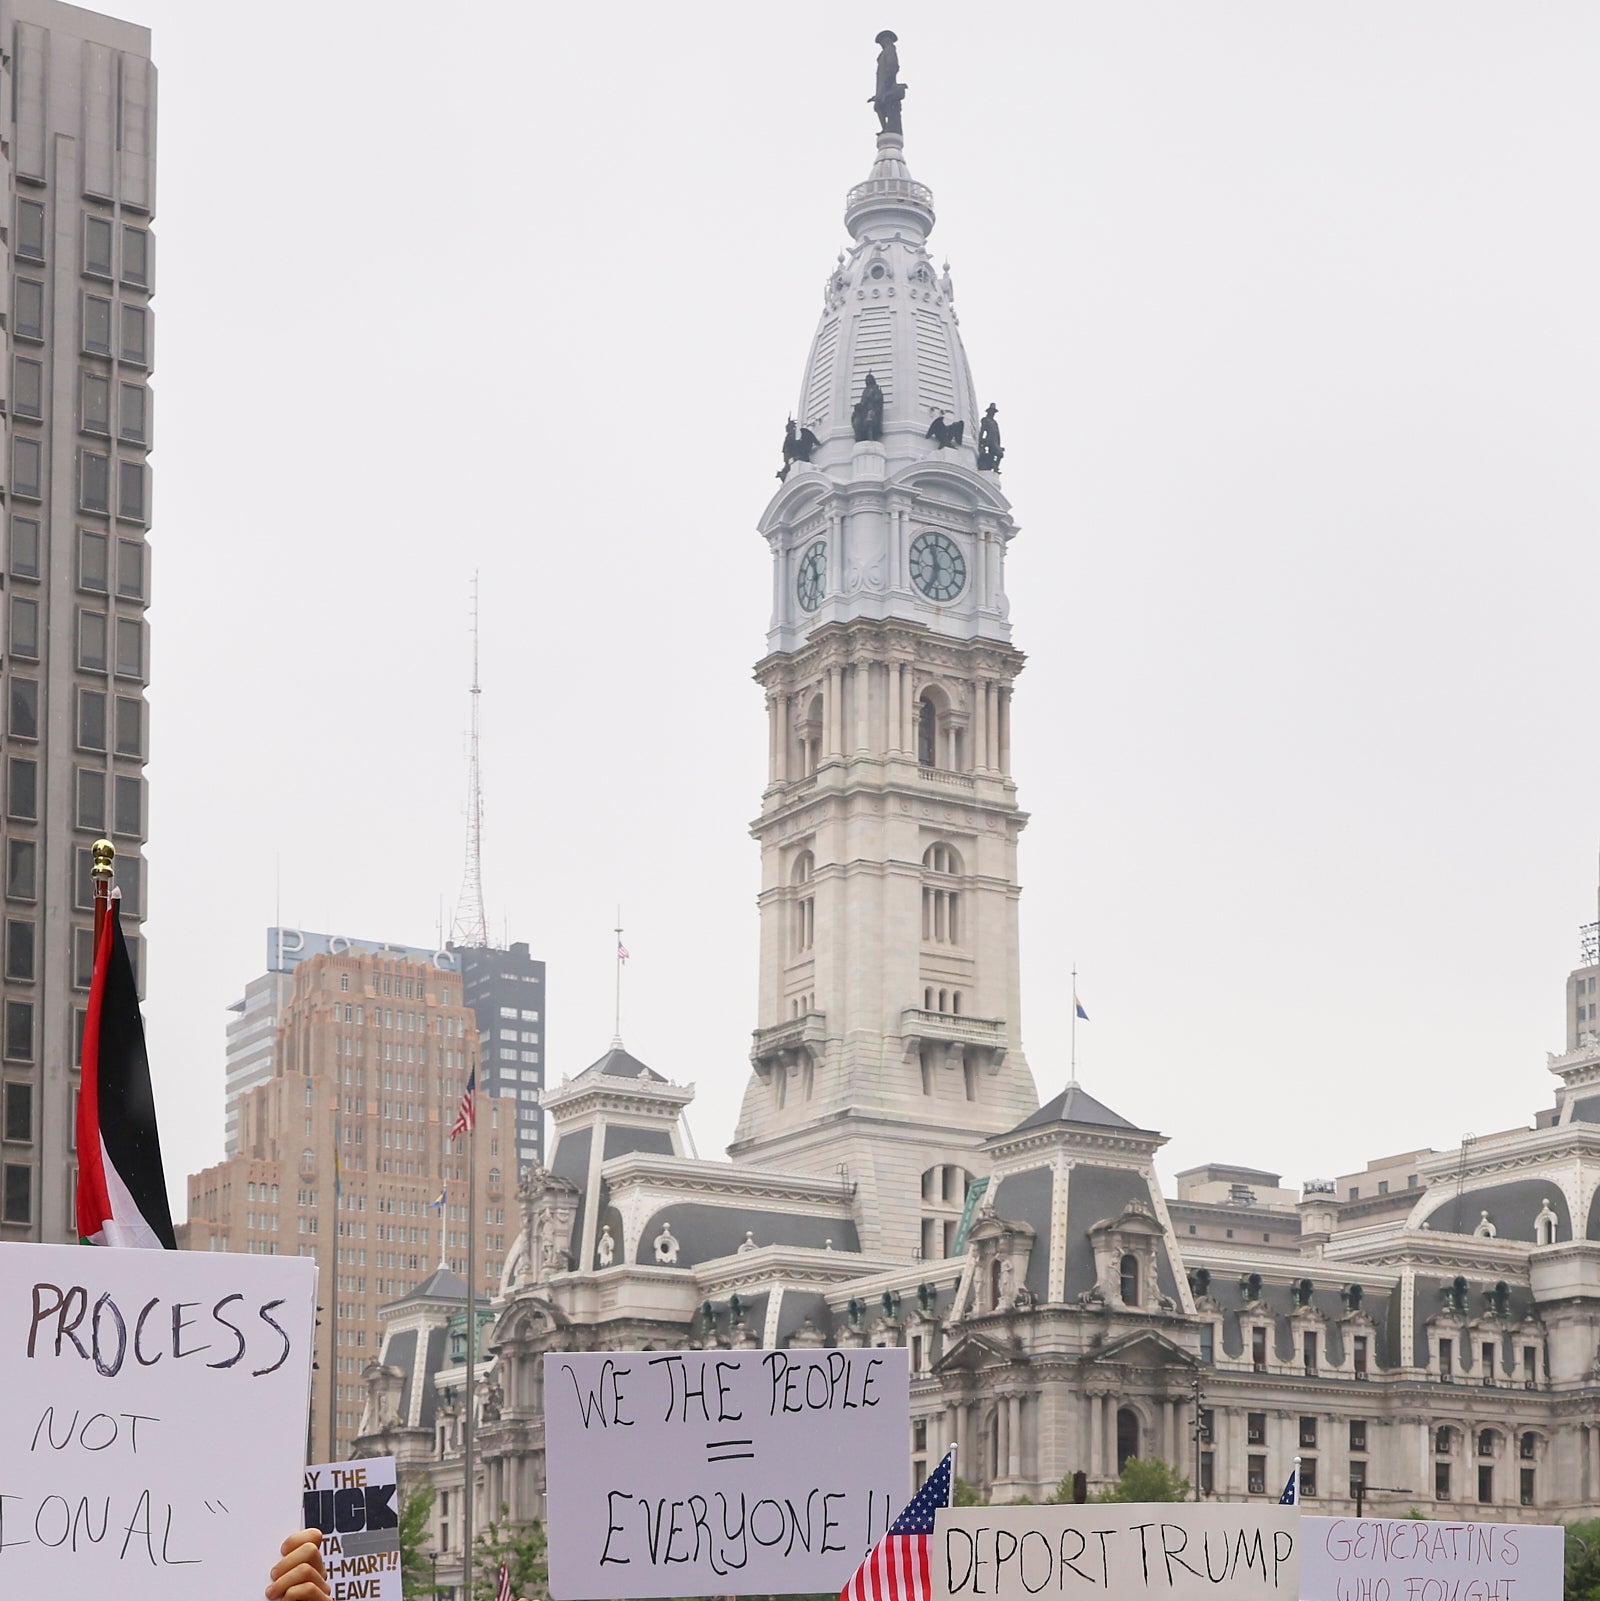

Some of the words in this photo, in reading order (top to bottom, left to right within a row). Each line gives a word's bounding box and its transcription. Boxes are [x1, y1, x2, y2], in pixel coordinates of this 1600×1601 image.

[26, 1283, 292, 1376] PROCESS
[561, 1364, 635, 1430] WE
[648, 1355, 742, 1422] THE
[762, 1352, 883, 1417] PEOPLE
[31, 1406, 161, 1453] NOT
[331, 1468, 367, 1489] THE
[304, 1484, 398, 1535] UCK
[947, 1527, 1117, 1594] DEPORT
[1130, 1523, 1293, 1588] TRUMP
[332, 1579, 381, 1601] EAVE
